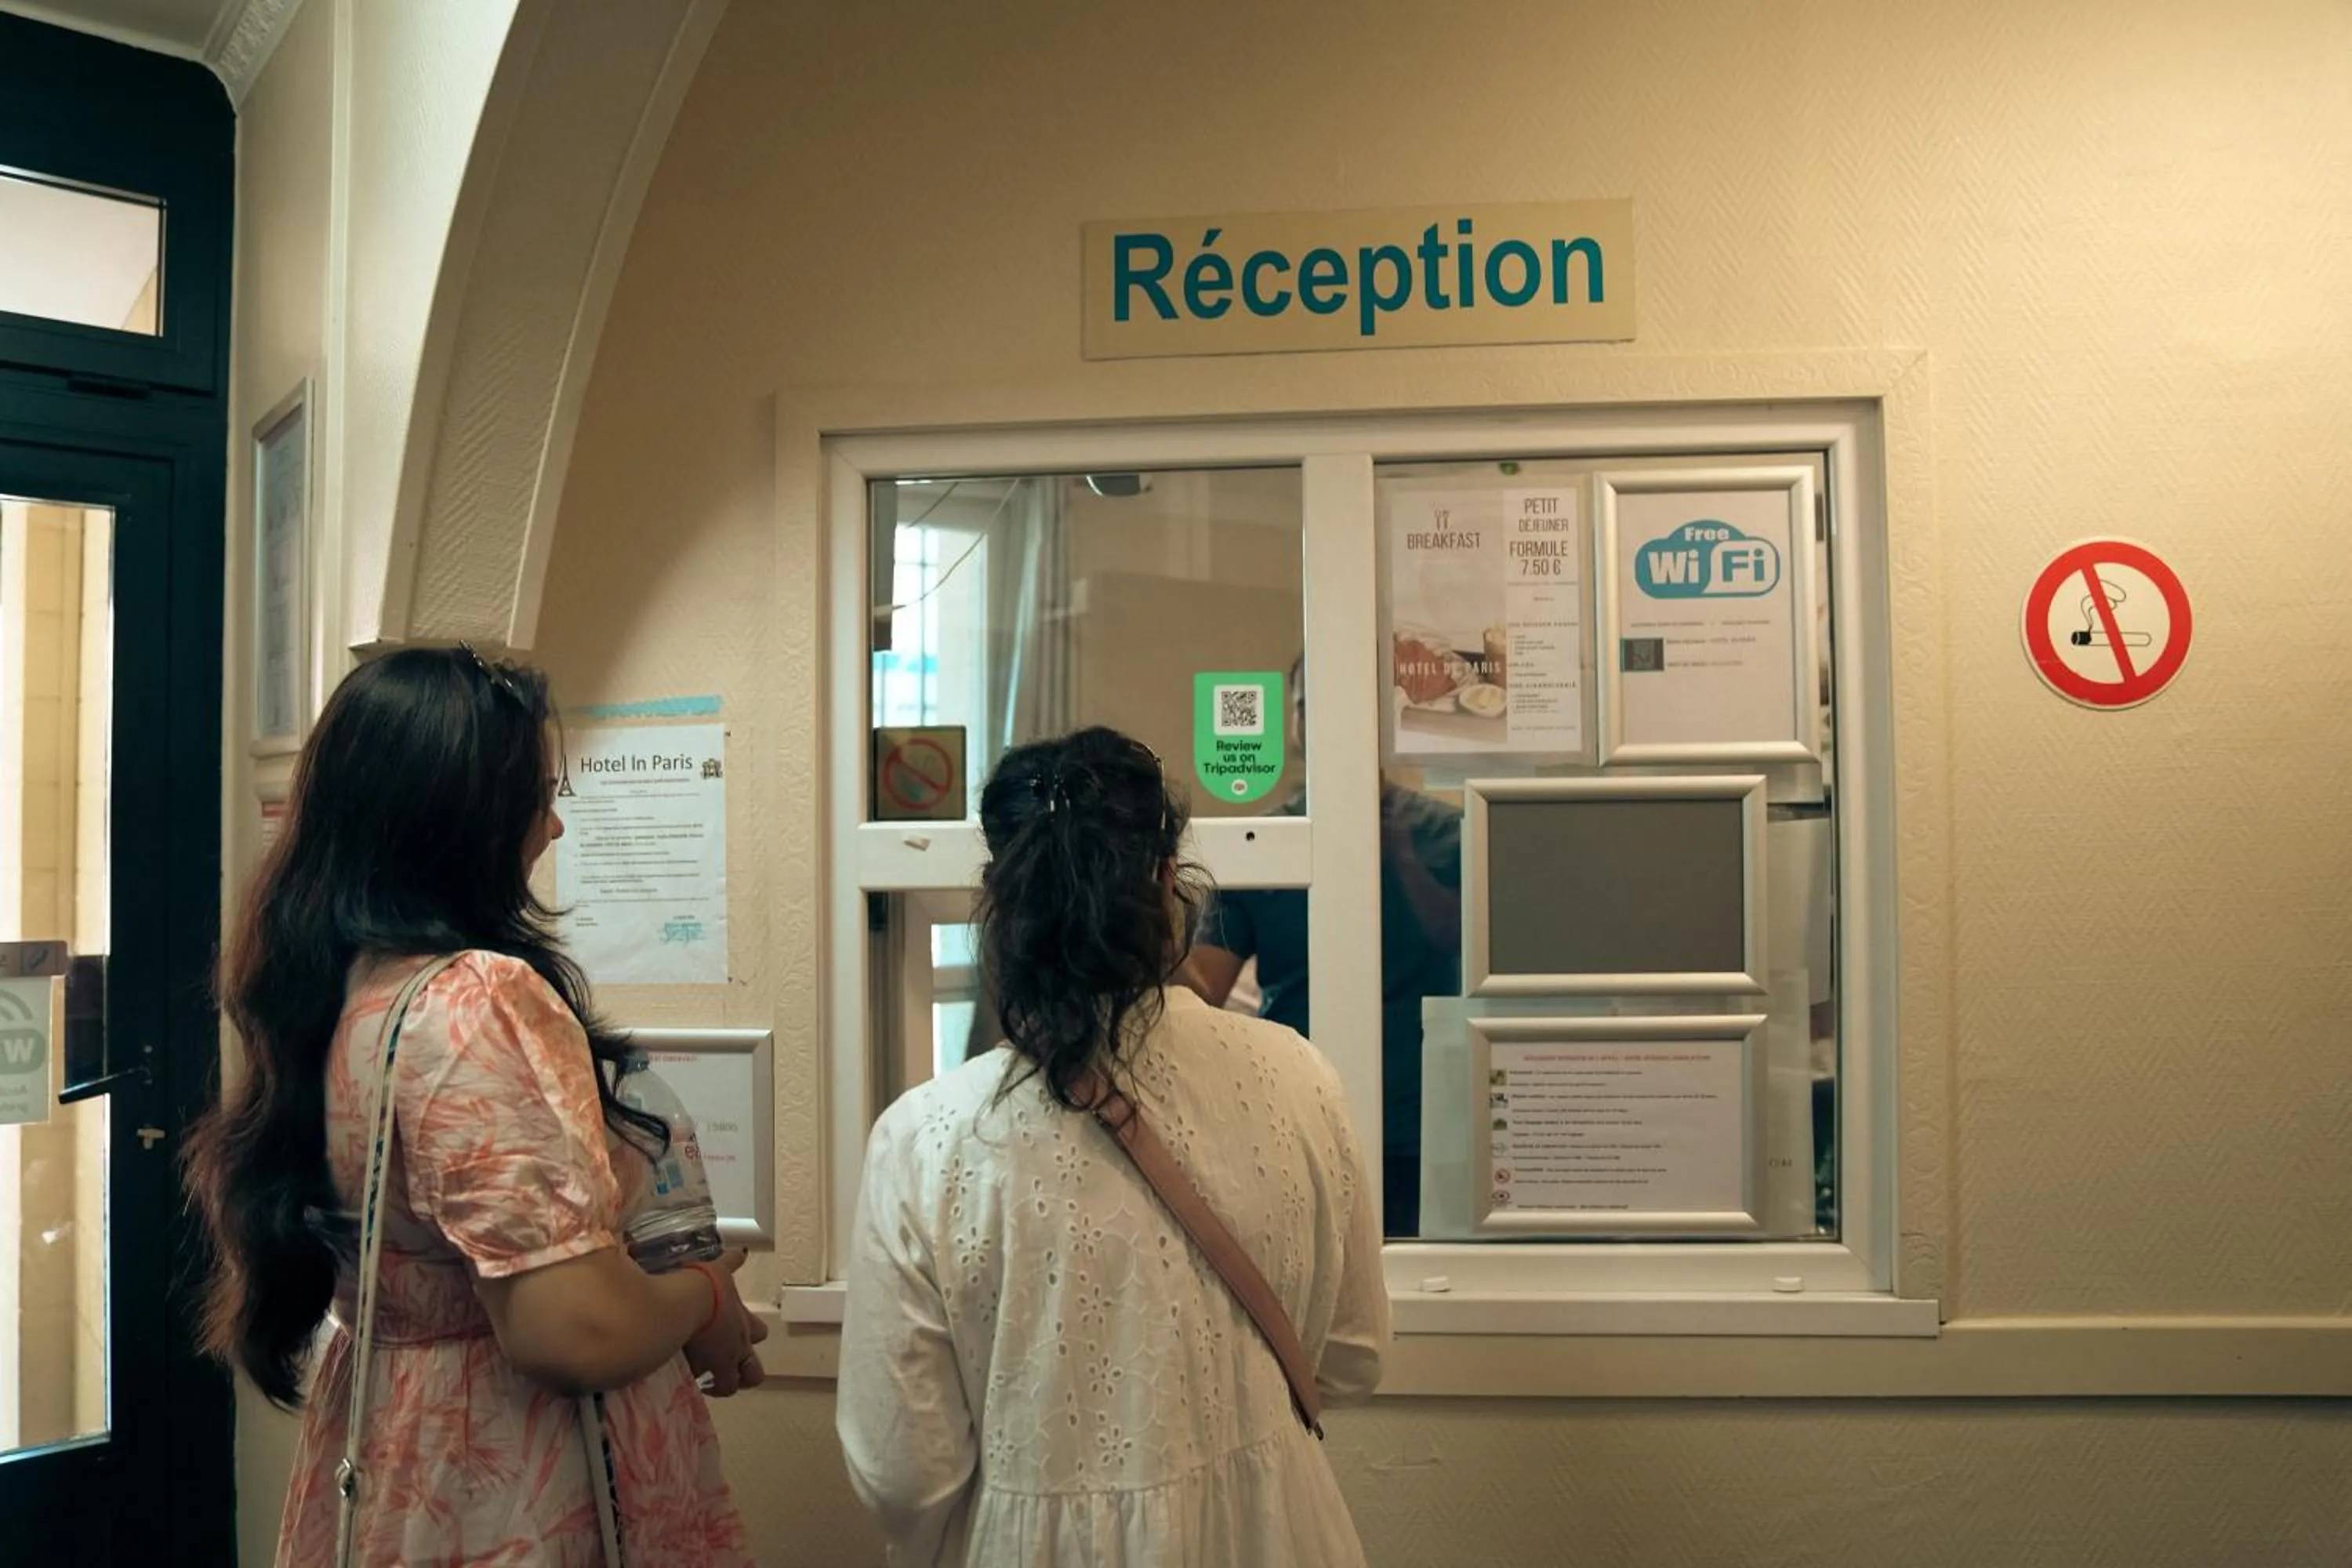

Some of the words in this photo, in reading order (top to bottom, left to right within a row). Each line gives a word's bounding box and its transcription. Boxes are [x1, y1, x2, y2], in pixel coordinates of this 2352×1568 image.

[1114, 219, 1603, 336] Réception
[1524, 497, 1559, 514] PETIT
[1406, 532, 1480, 550] BREAKFAST
[1684, 527, 1730, 542] Free
[1509, 540, 1569, 557] FORMULE
[1399, 661, 1436, 675] HOTEL
[1216, 740, 1262, 751] Review
[581, 754, 626, 772] Hotel
[631, 754, 647, 771] In
[652, 753, 693, 771] Paris
[1223, 753, 1236, 762] us
[1240, 753, 1256, 762] on
[1203, 762, 1276, 776] Tripadvisor
